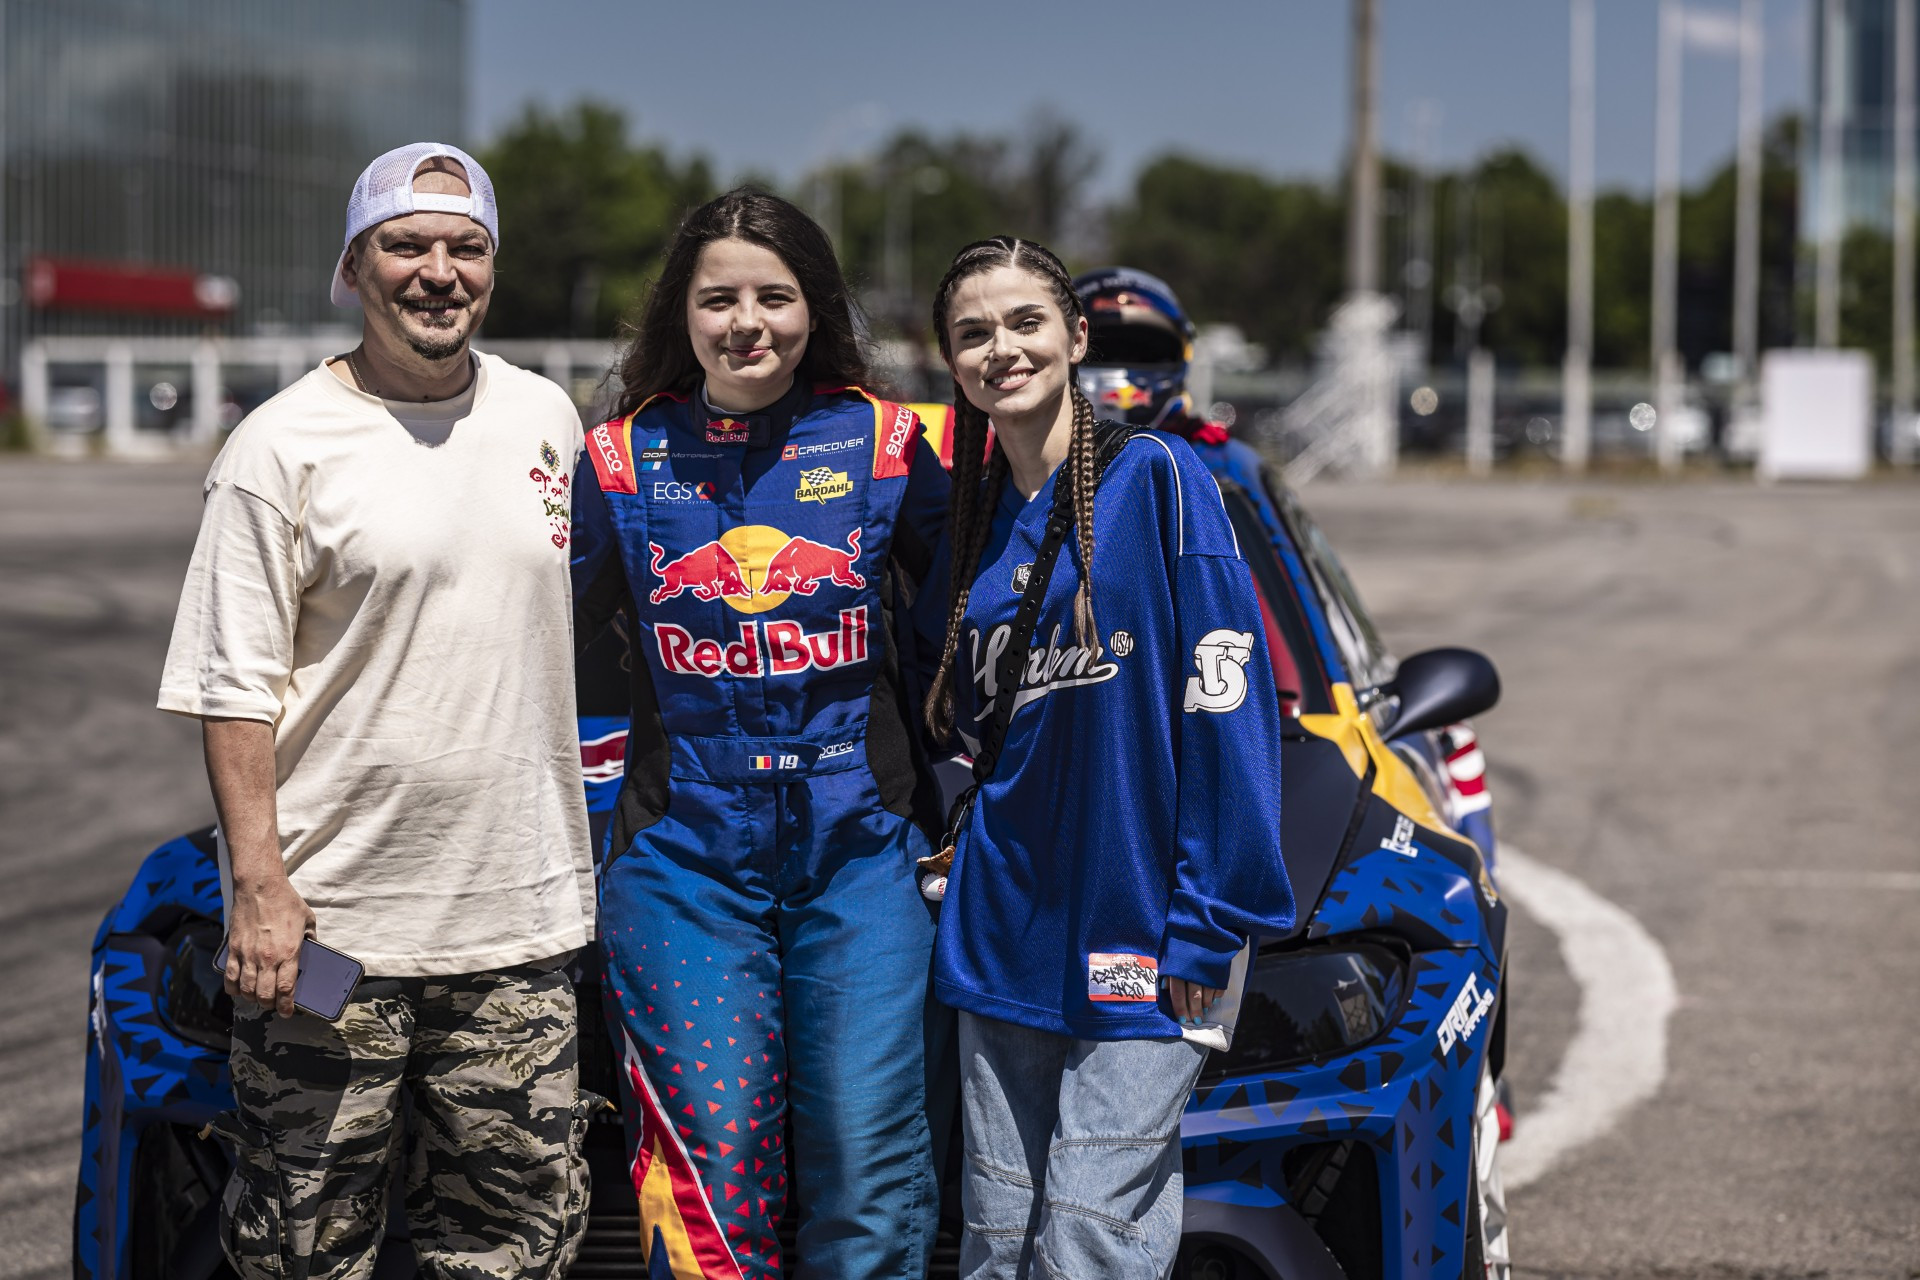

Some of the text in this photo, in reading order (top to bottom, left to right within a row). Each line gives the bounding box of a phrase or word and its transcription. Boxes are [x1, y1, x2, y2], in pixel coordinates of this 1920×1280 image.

[705, 430, 750, 443] Red Bull
[886, 406, 912, 458] sparco
[798, 437, 864, 455] CARCOVER
[653, 481, 693, 500] EGS
[796, 482, 852, 499] BARDAHL
[653, 605, 868, 678] Red Bull
[818, 741, 854, 760] parco
[778, 755, 799, 770] 19
[1436, 971, 1481, 1056] DRIFT
